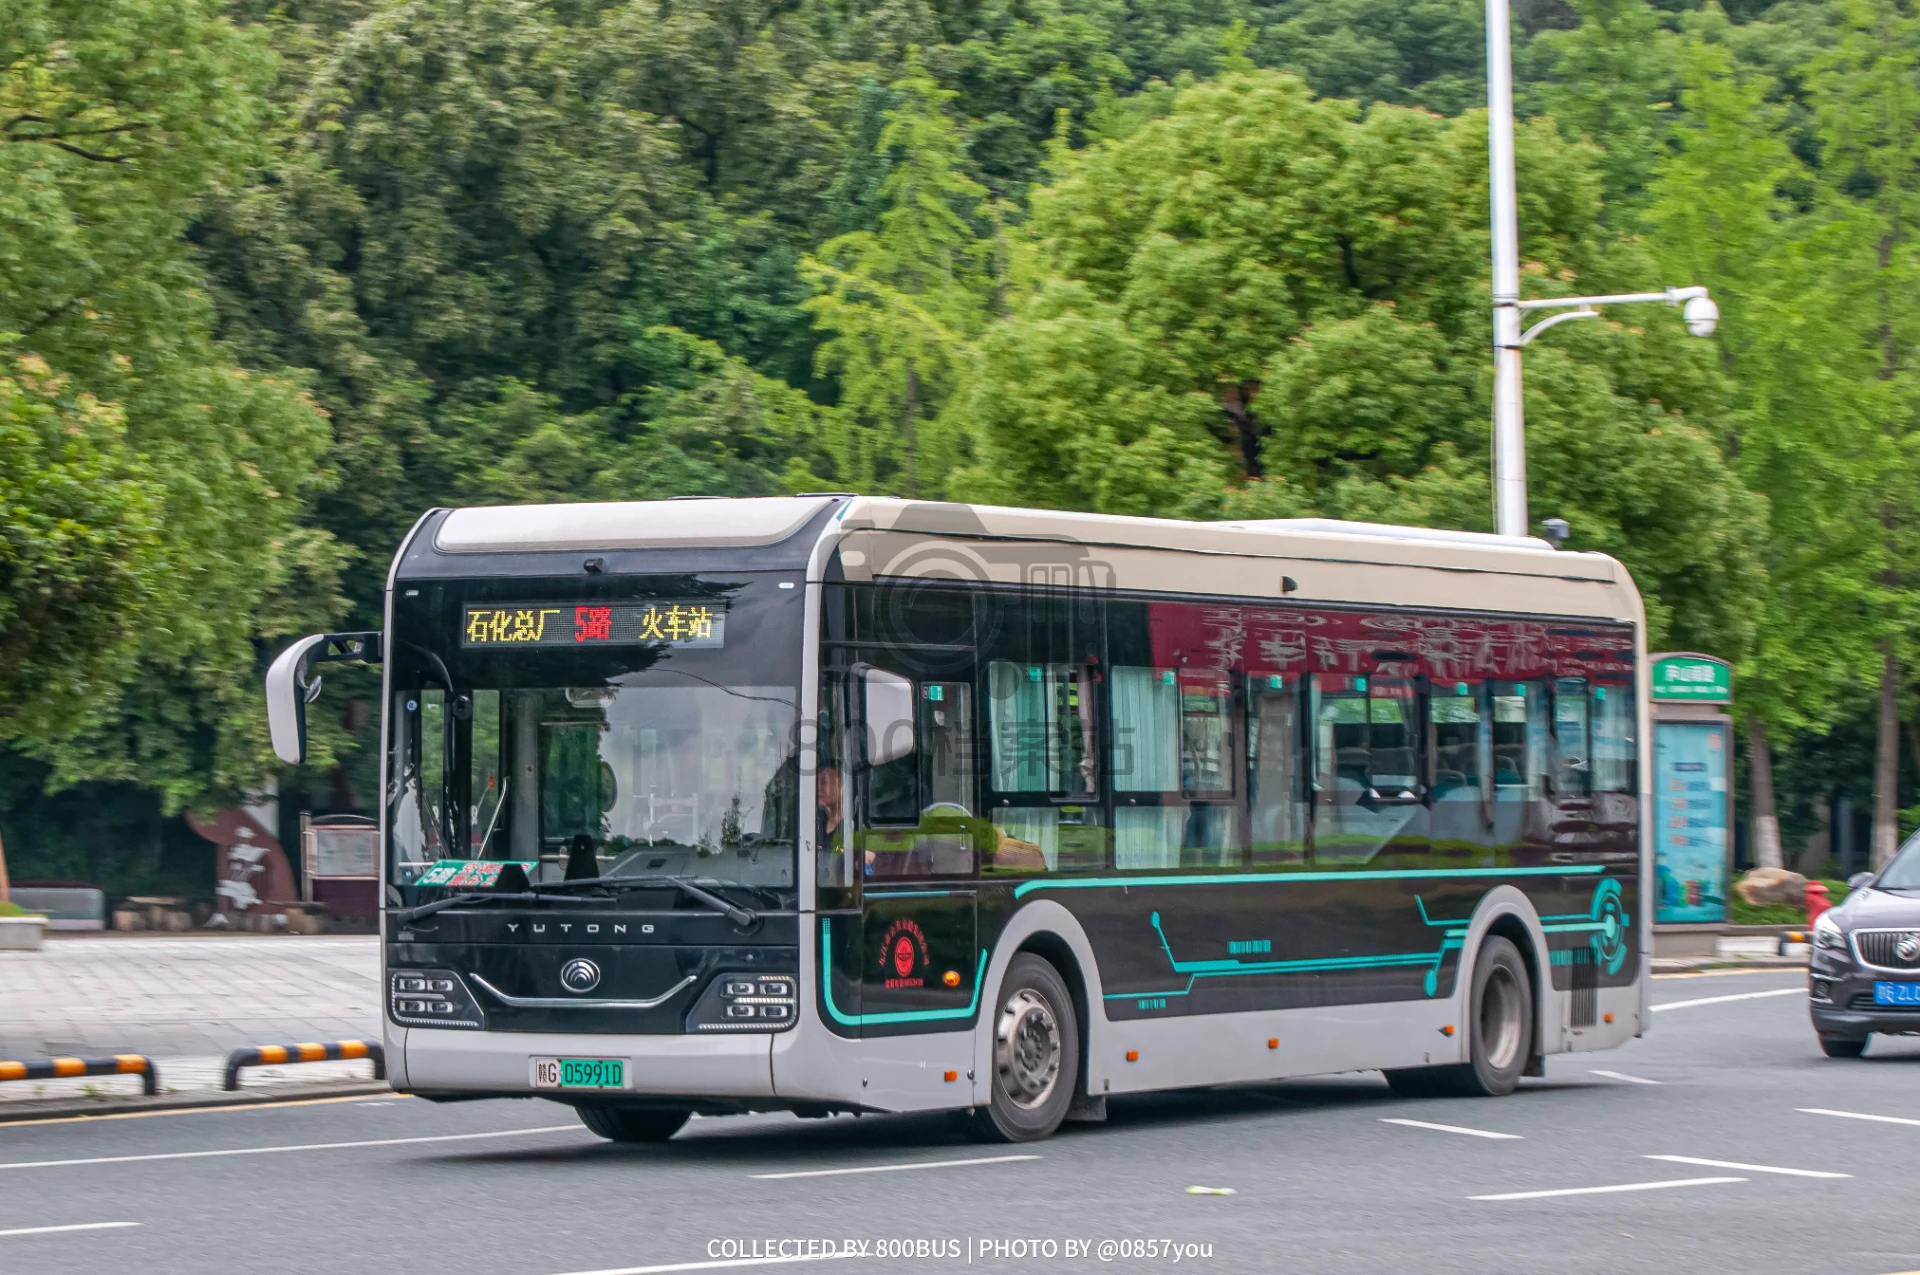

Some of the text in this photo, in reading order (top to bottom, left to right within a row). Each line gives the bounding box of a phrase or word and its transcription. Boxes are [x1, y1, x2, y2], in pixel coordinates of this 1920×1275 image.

[466, 605, 714, 642] 石化总厂 5路 火车站
[507, 922, 656, 935] YUTONG
